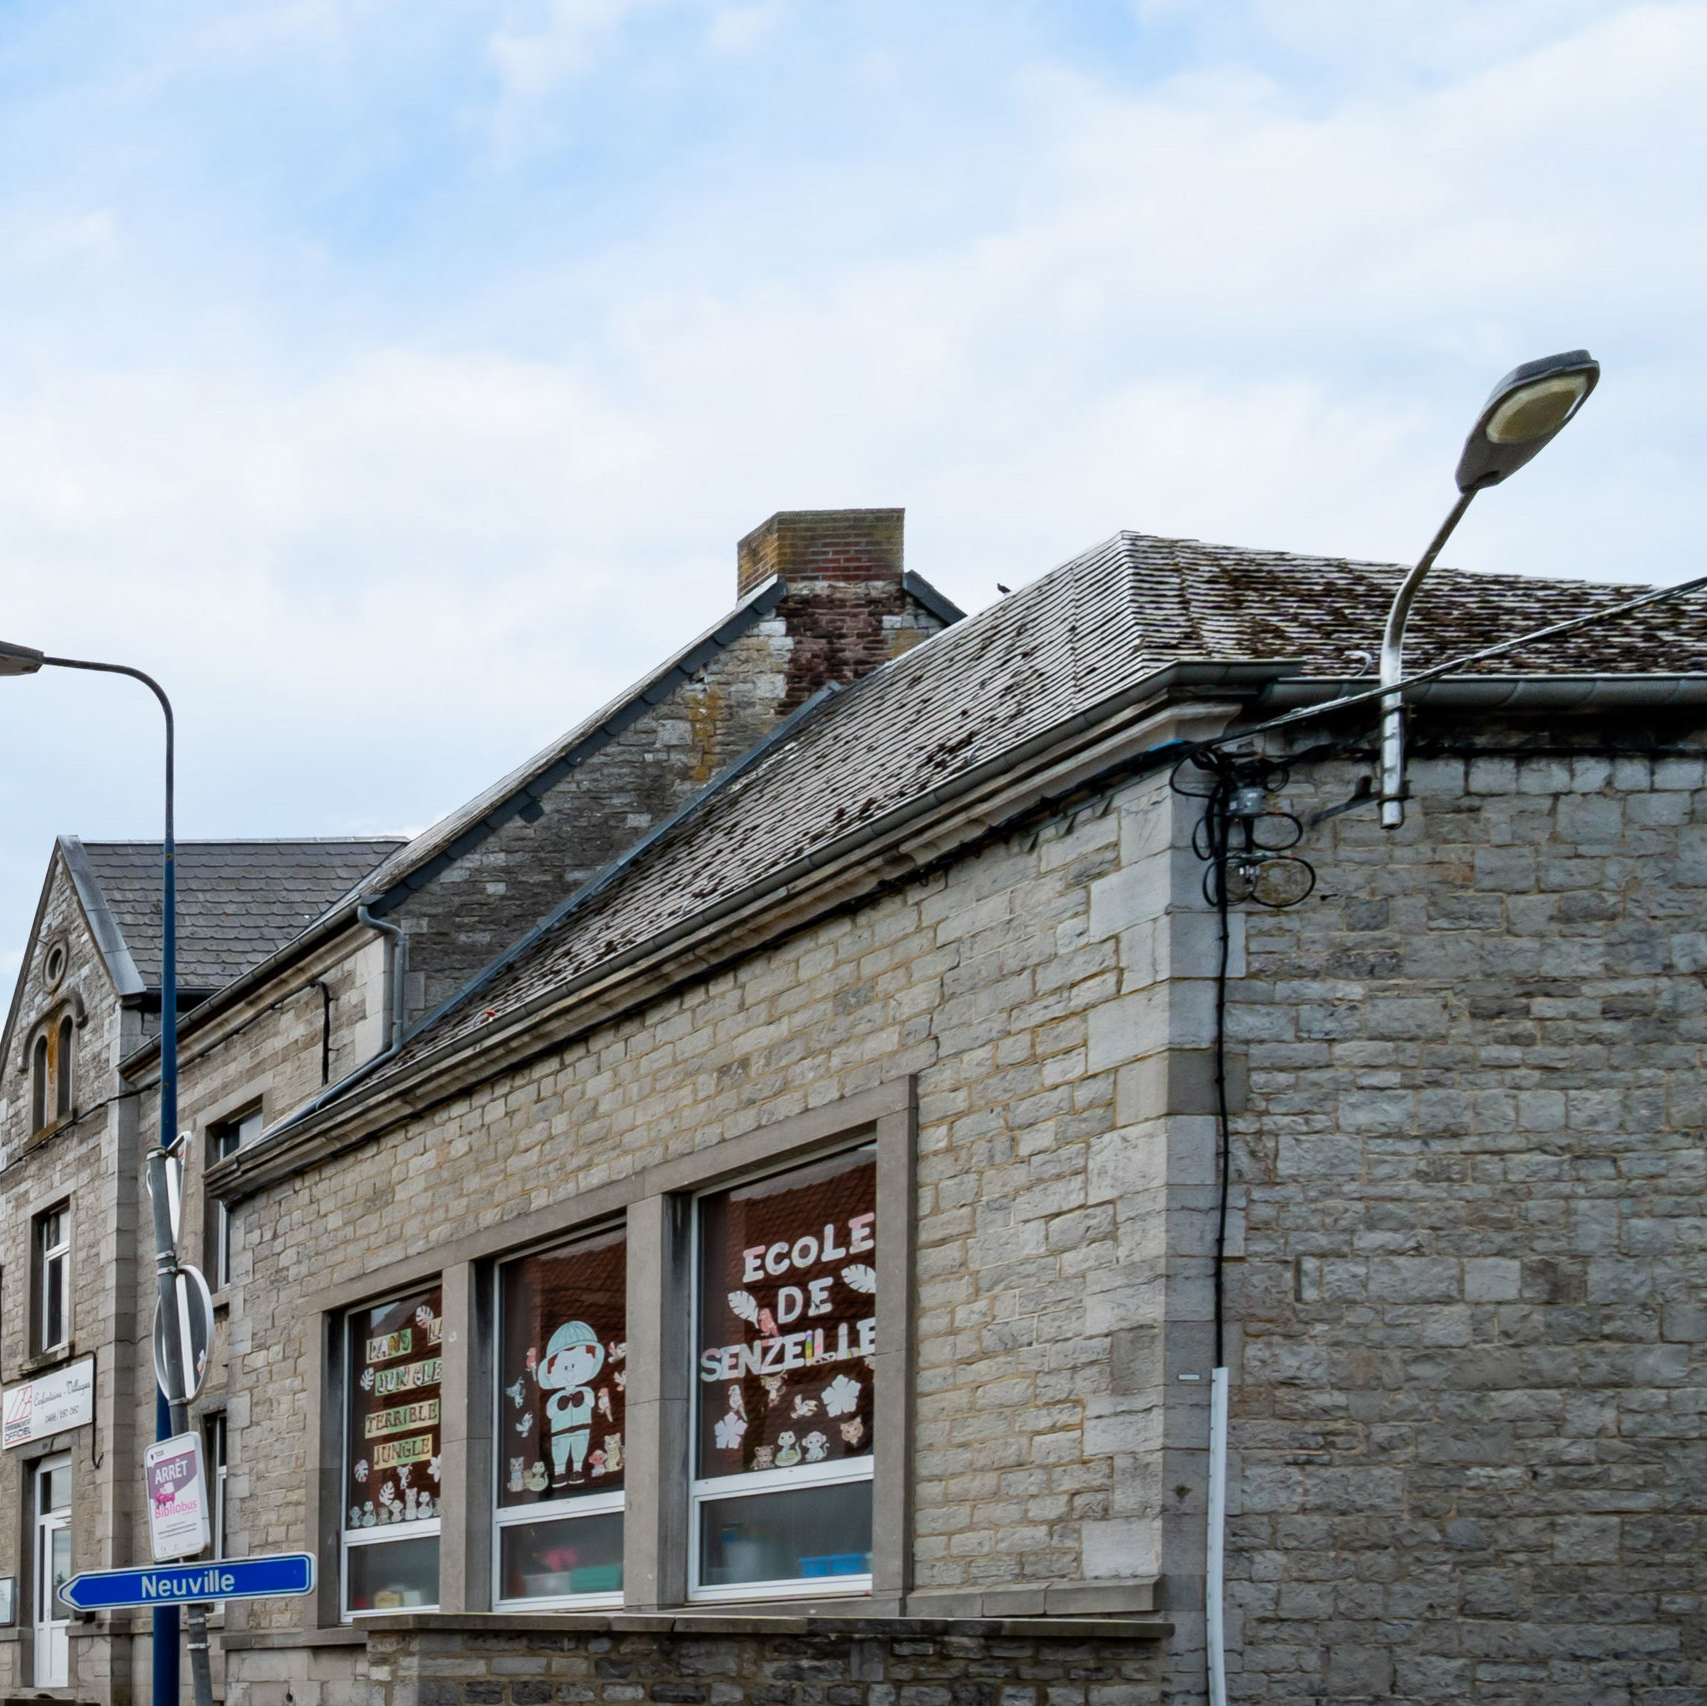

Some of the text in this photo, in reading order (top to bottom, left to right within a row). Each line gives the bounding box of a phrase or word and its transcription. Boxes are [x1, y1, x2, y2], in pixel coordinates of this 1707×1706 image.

[742, 1212, 875, 1283] ECOLE
[777, 1276, 834, 1324] DE
[369, 1330, 411, 1361] DANS
[367, 1403, 437, 1433] TERRIBLE
[375, 1440, 430, 1465] JUNGLE
[154, 1458, 188, 1485] ARRÊT
[154, 1499, 198, 1520] Bibliobus
[141, 1569, 235, 1598] Neuville
